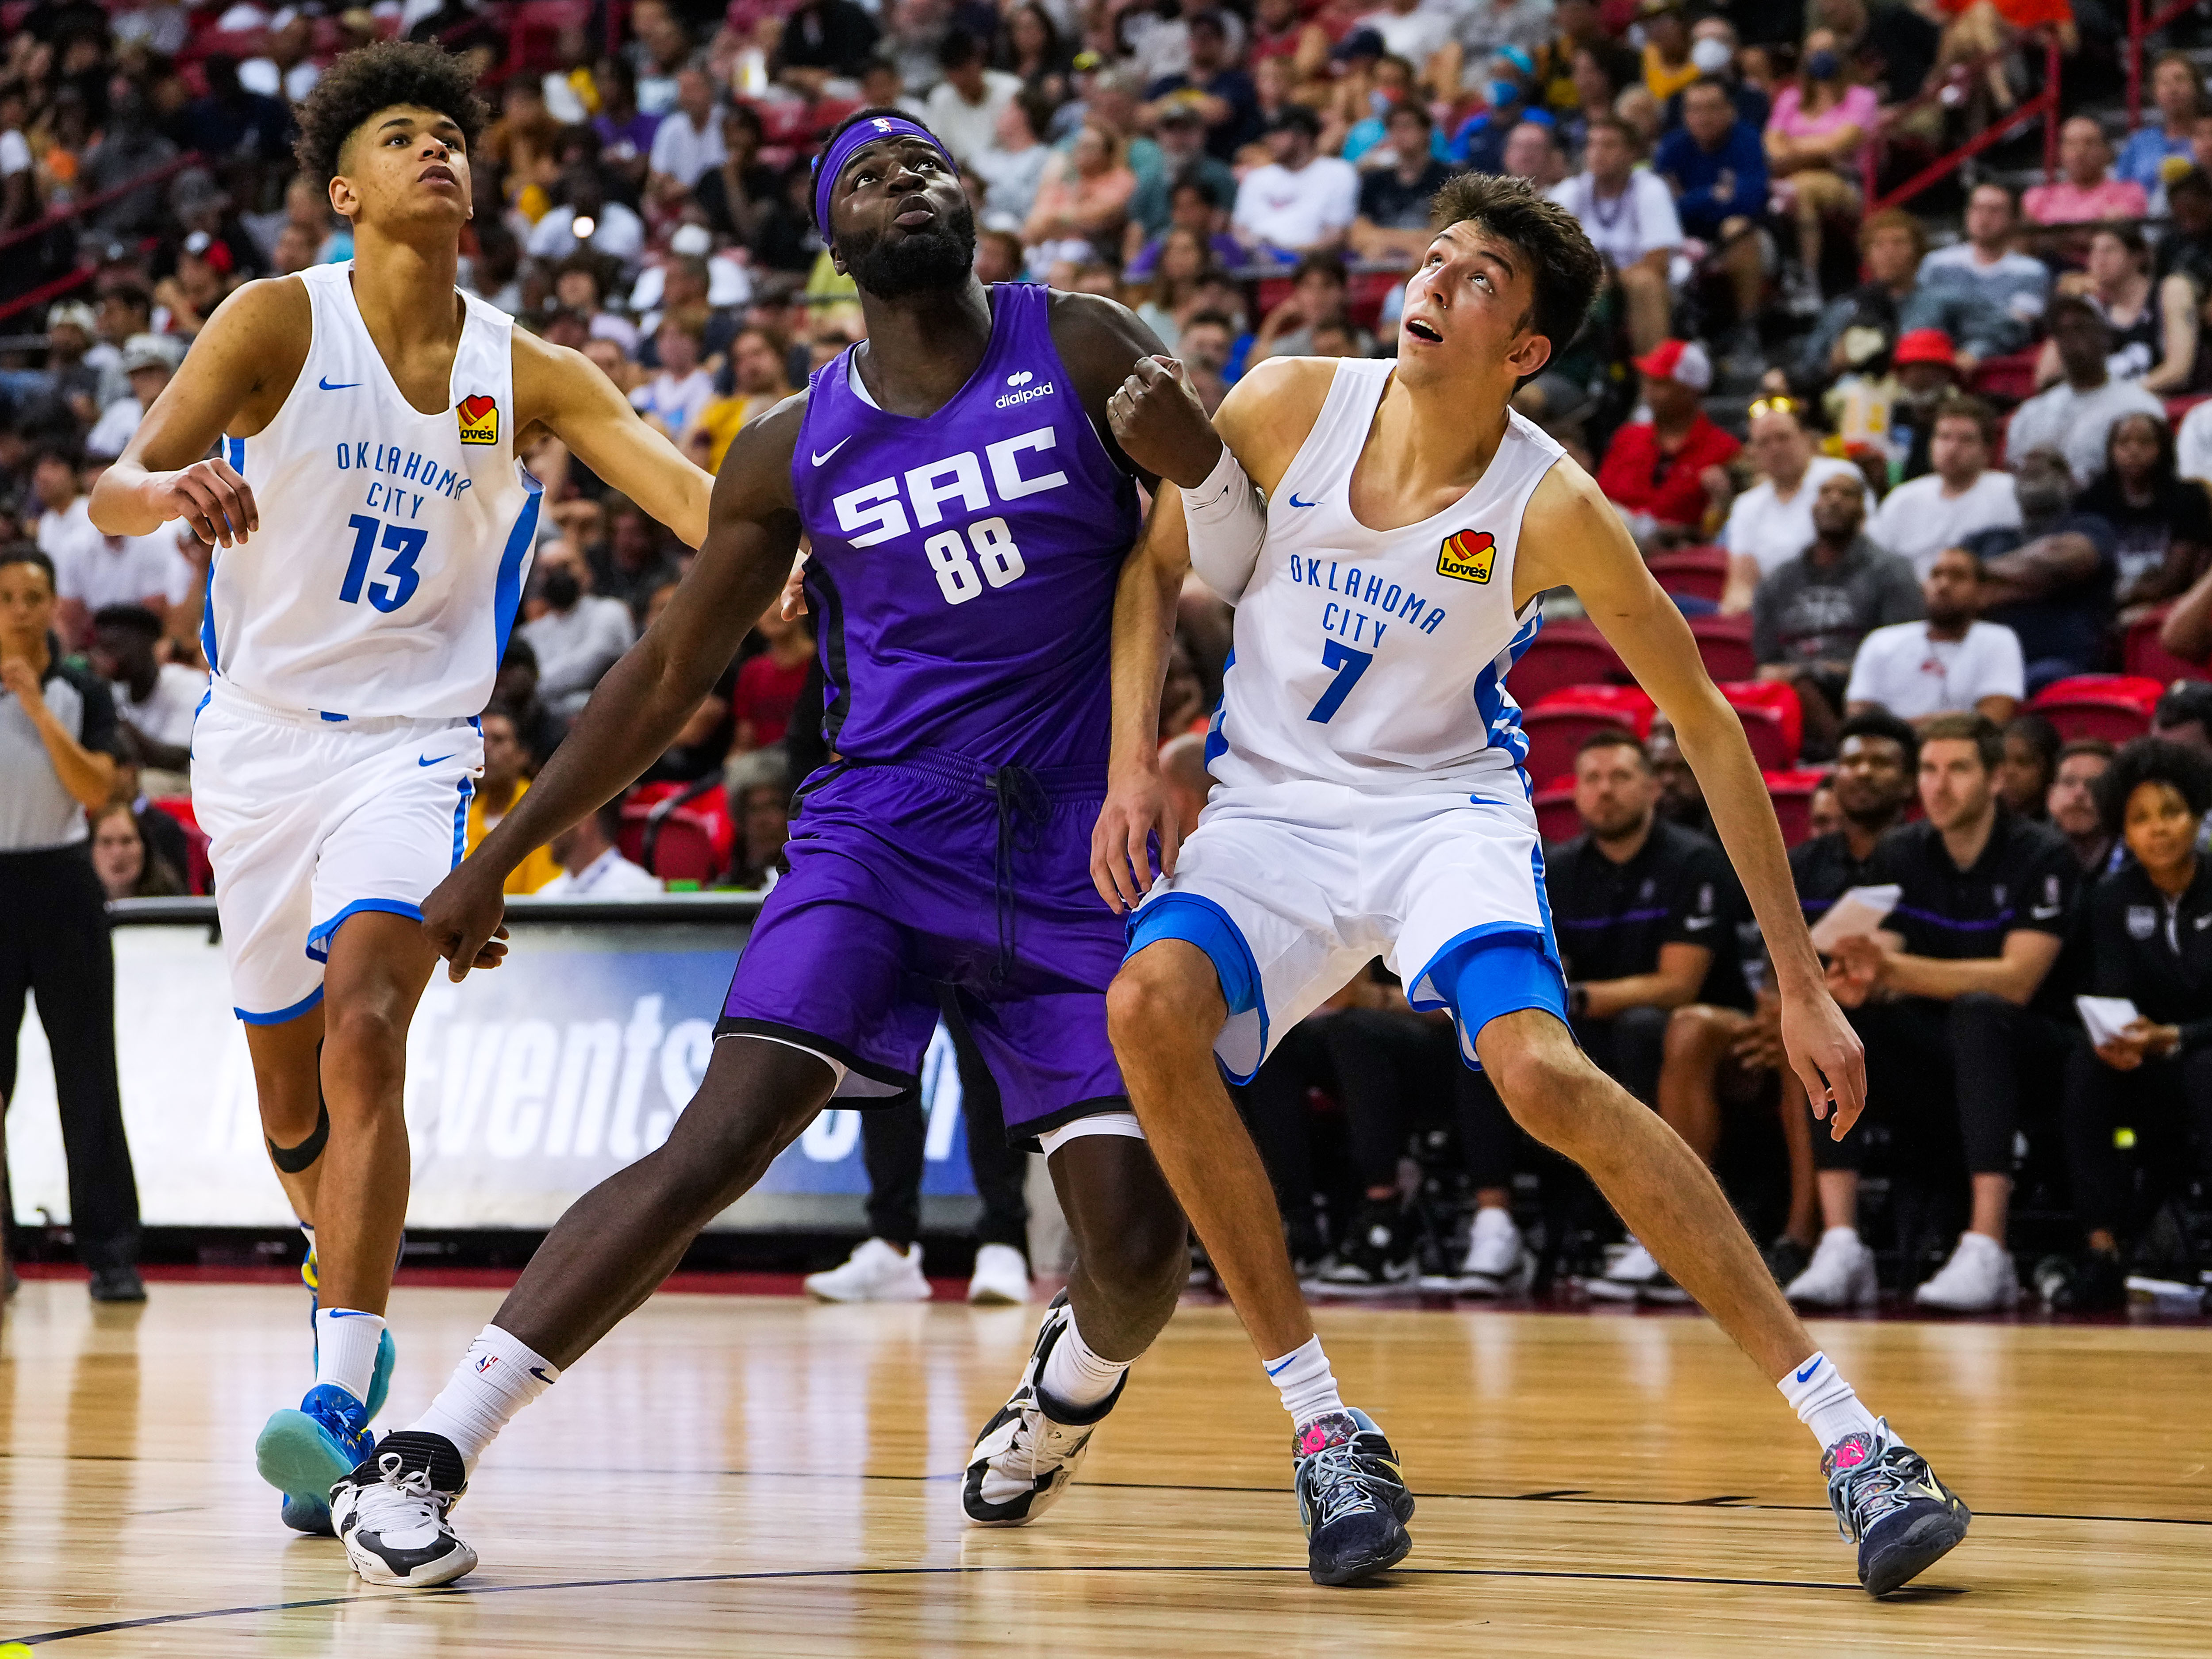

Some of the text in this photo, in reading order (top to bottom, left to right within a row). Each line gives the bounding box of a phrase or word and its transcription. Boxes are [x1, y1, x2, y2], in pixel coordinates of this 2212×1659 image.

[995, 381, 1054, 408] dialpad
[337, 442, 472, 500] OKLAHOMA
[366, 482, 424, 519] CITY
[832, 426, 1069, 549] SAC
[338, 514, 429, 613] 13
[924, 516, 1026, 605] 88
[1290, 554, 1446, 635] OKLAHOMA
[1322, 602, 1387, 648] CITY
[1306, 637, 1373, 724] 7
